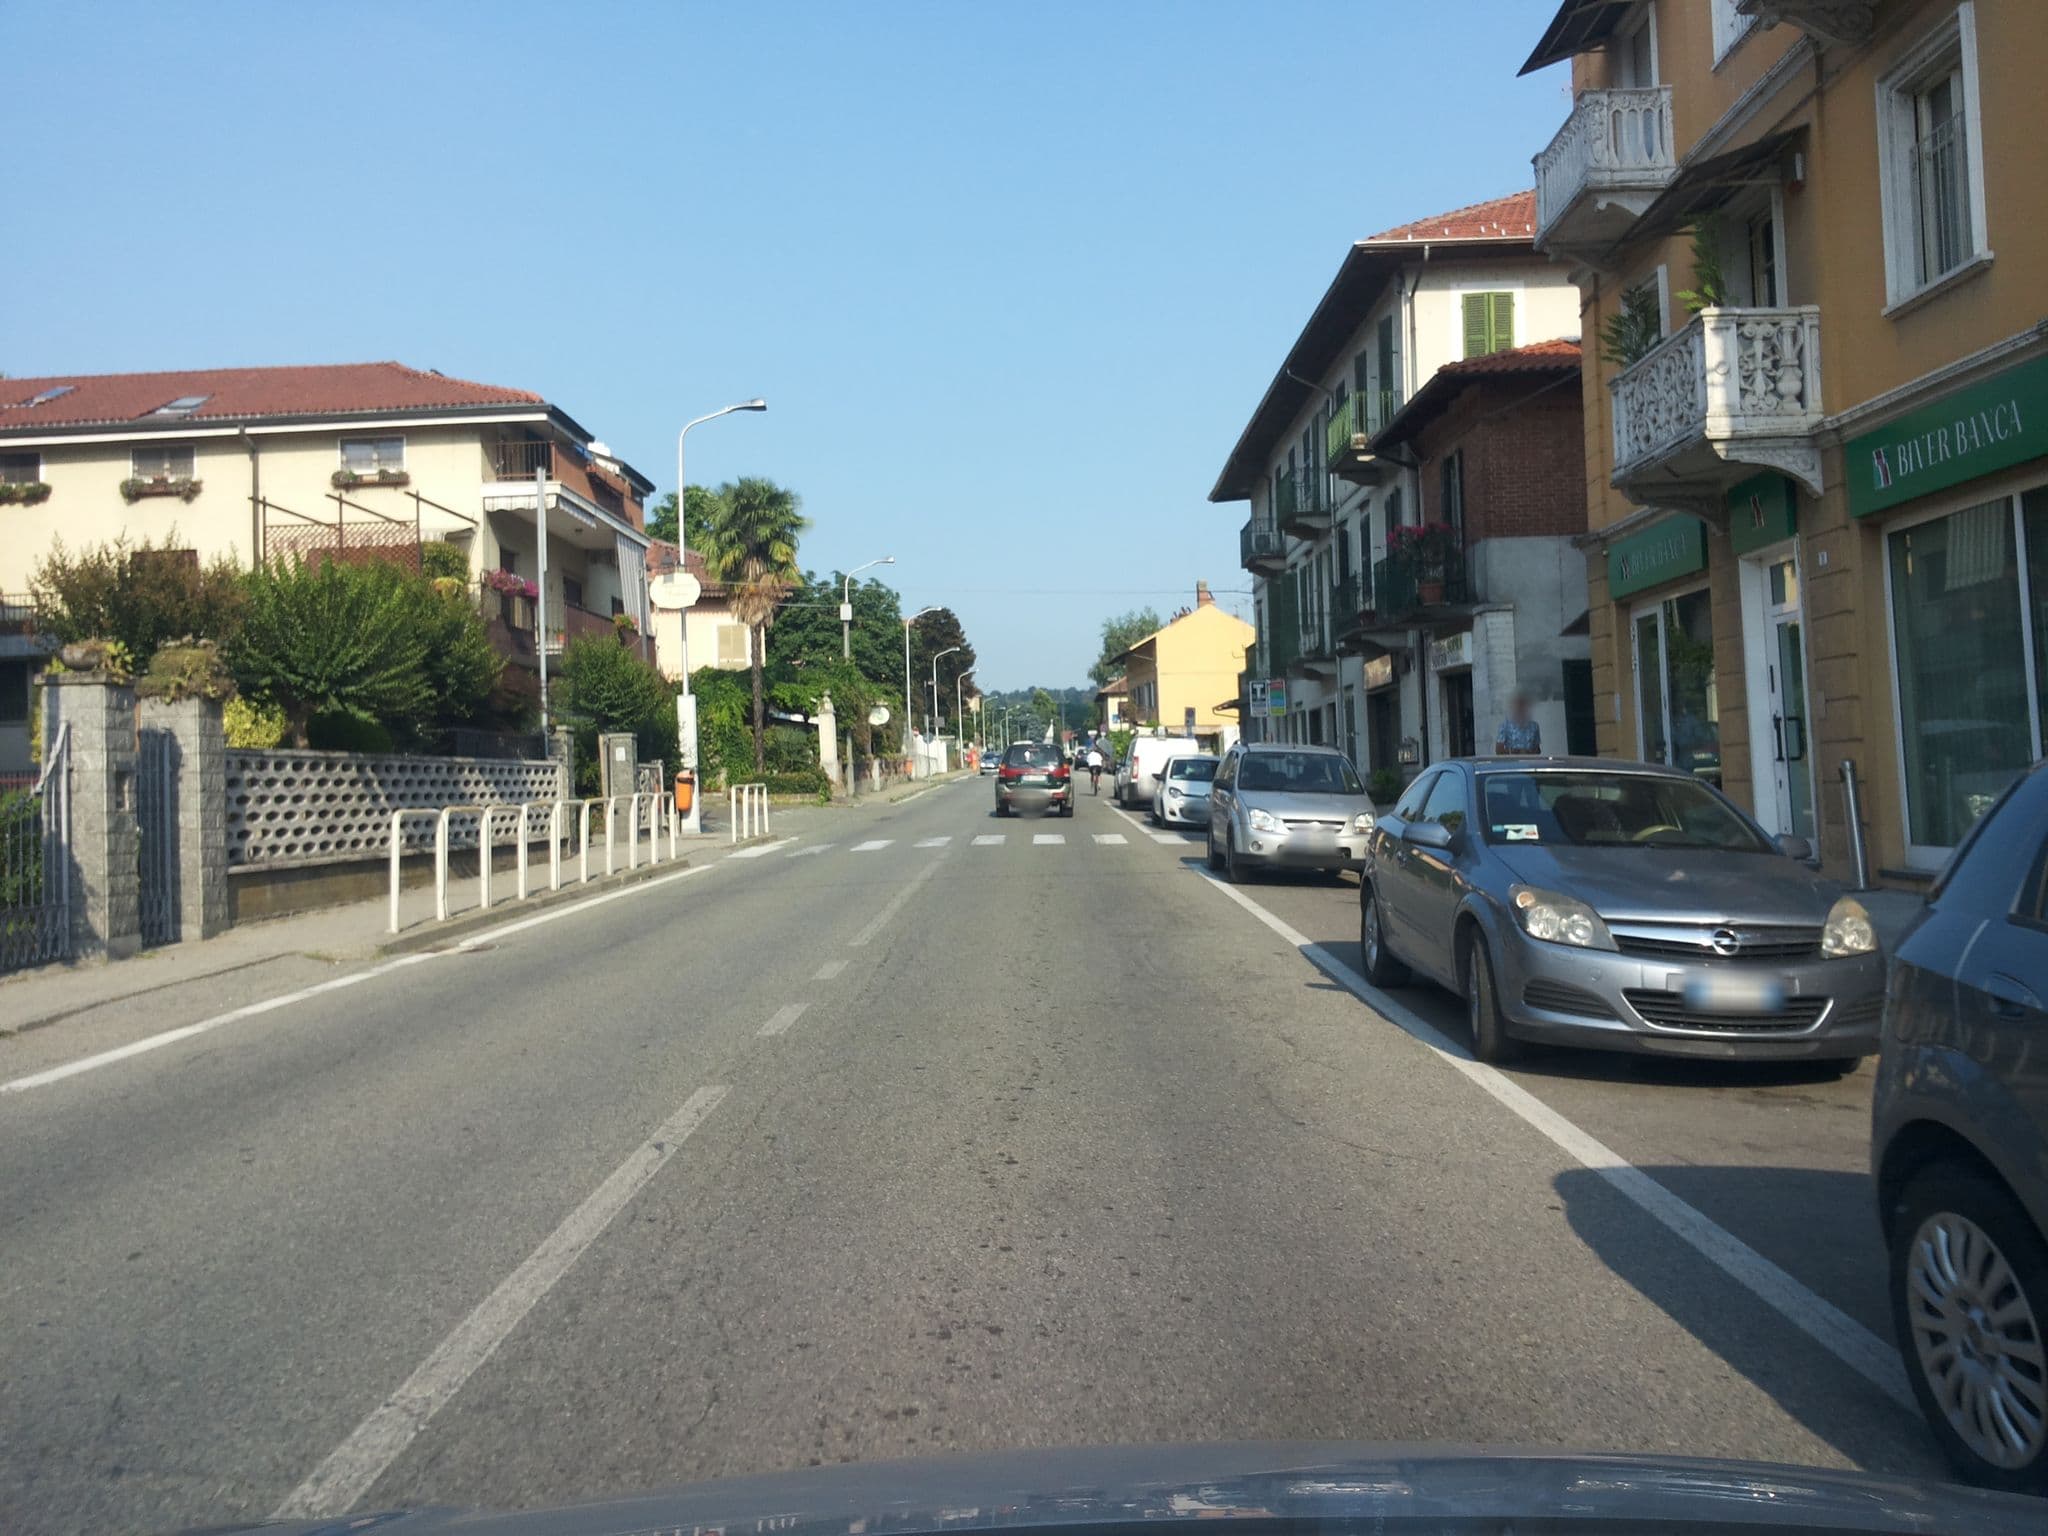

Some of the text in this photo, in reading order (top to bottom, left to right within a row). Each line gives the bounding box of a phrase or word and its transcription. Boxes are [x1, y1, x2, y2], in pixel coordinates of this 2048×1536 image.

[1897, 400, 2022, 477] BIVER BANCA
[1252, 683, 1264, 699] T
